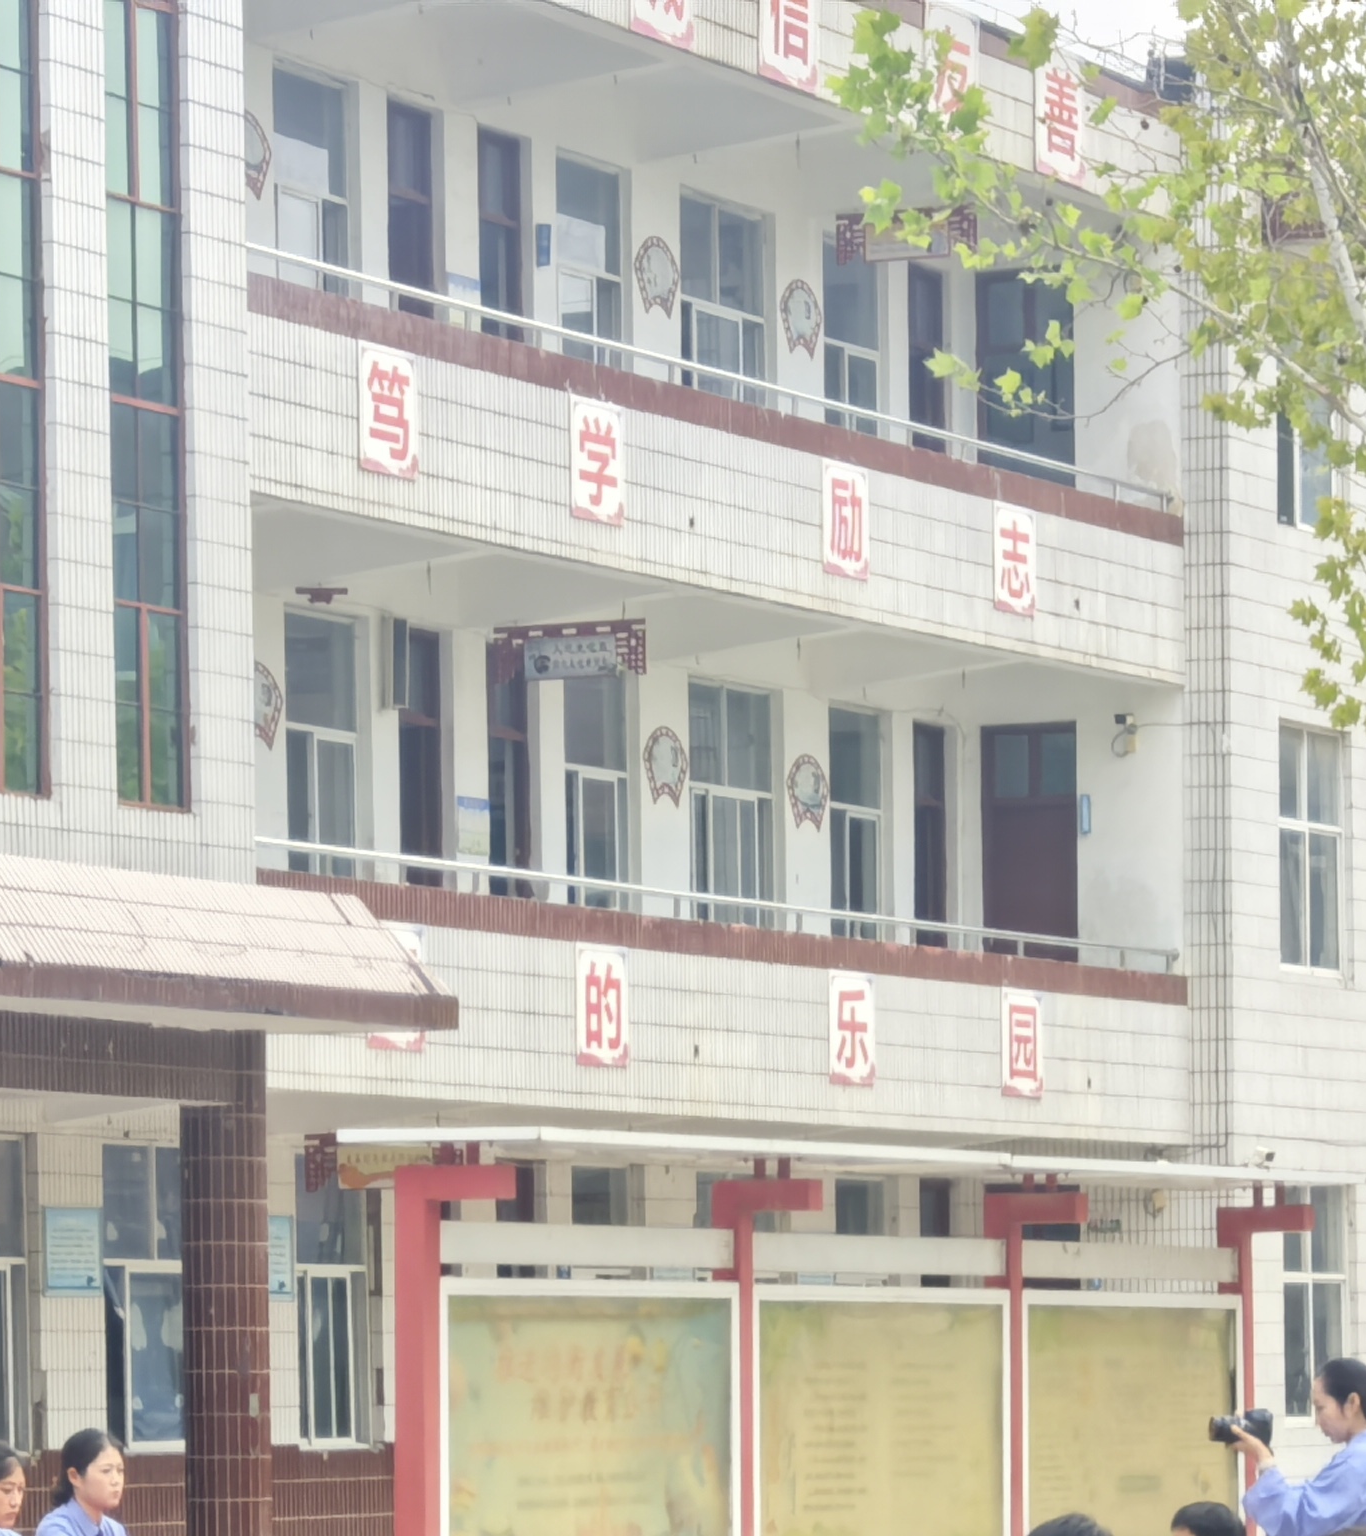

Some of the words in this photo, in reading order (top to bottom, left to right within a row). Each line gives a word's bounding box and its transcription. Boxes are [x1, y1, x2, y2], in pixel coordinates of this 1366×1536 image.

[1044, 67, 1079, 161] 善
[367, 362, 414, 463] 笃
[578, 416, 619, 508] 学
[830, 478, 864, 563] 励
[999, 523, 1033, 600] 志
[584, 963, 623, 1053] 的
[836, 989, 870, 1071] 乐
[1008, 1003, 1038, 1082] 园
